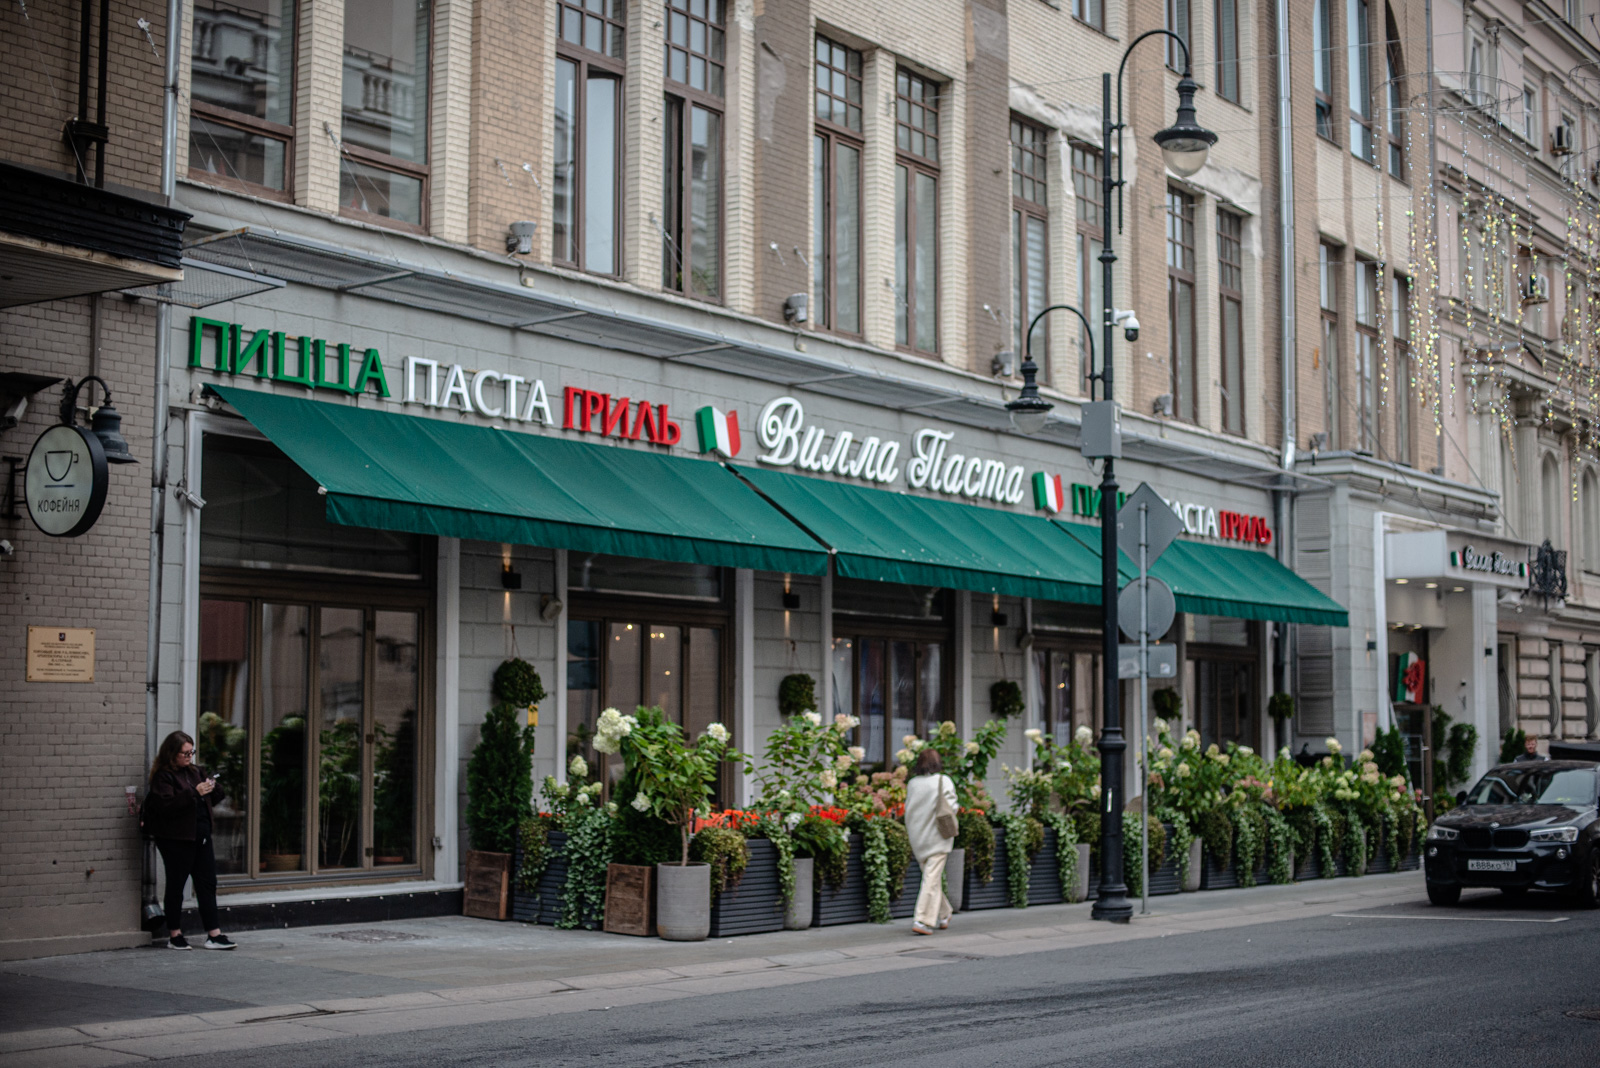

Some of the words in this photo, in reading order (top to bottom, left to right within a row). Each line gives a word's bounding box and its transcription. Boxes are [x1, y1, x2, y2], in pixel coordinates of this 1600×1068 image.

[188, 316, 391, 397] ПИЦЦА
[403, 356, 553, 425] ПАСТА
[563, 386, 681, 446] ГРИЛЬ
[757, 396, 900, 483] Вилла
[906, 428, 1025, 504] Паста
[37, 496, 80, 513] КОФЕЙНЯ
[1219, 510, 1272, 544] ГРИЛЬ
